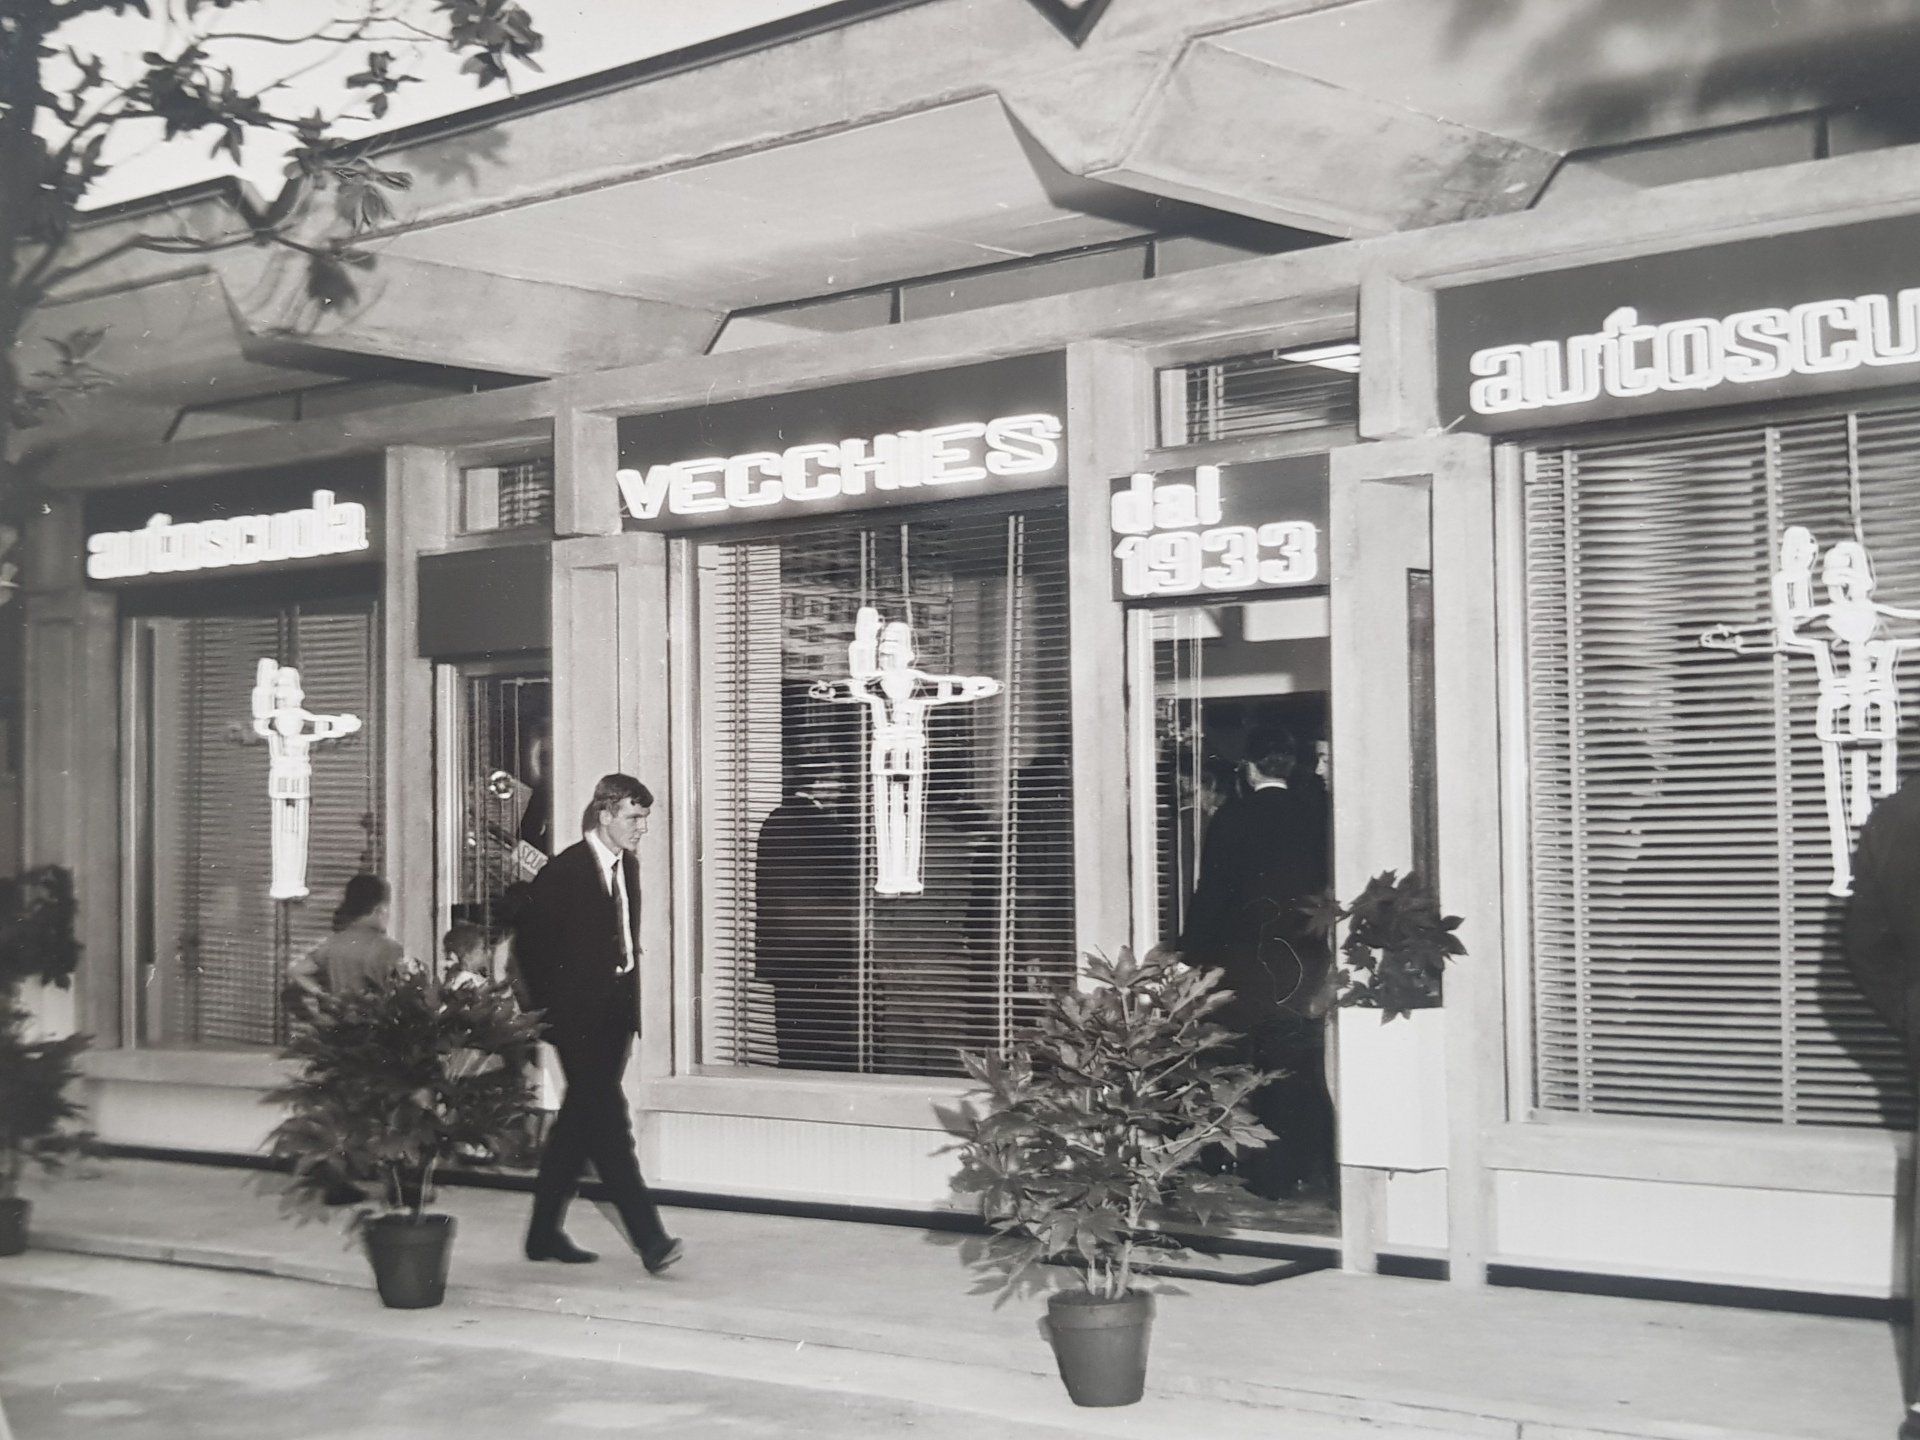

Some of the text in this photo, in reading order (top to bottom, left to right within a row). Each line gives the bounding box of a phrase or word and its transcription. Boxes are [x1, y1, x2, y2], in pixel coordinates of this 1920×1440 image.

[615, 413, 1063, 520] VECCHIES
[1110, 464, 1222, 535] dal
[87, 489, 369, 580] autoscuola
[1113, 520, 1319, 596] 1933
